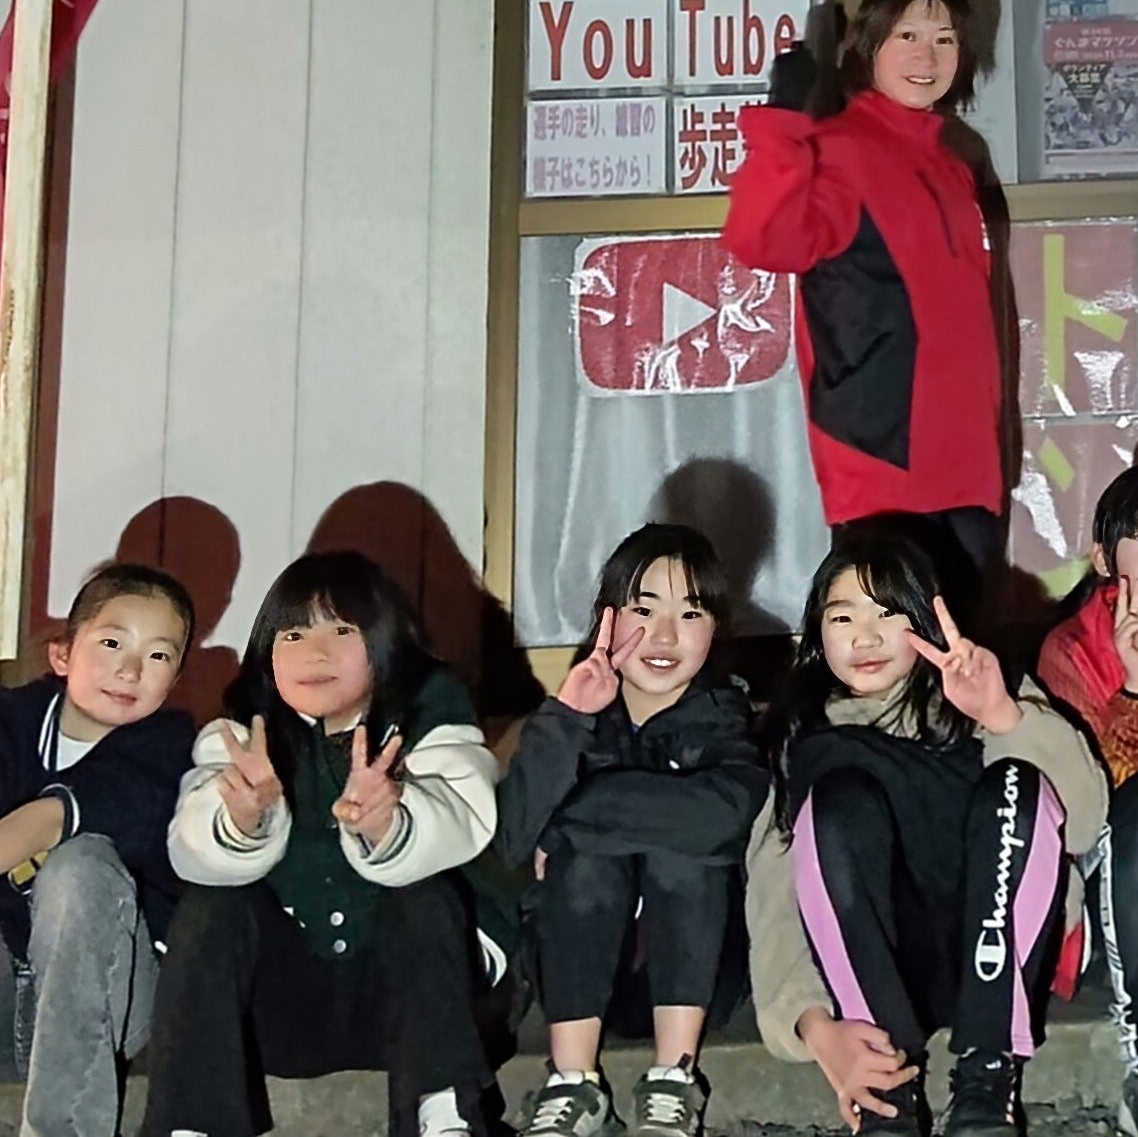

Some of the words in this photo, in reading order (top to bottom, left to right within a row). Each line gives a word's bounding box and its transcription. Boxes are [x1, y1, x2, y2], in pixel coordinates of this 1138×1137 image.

[539, 1, 653, 82] You
[679, 101, 762, 190] 歩走
[974, 764, 1026, 982] Champion
